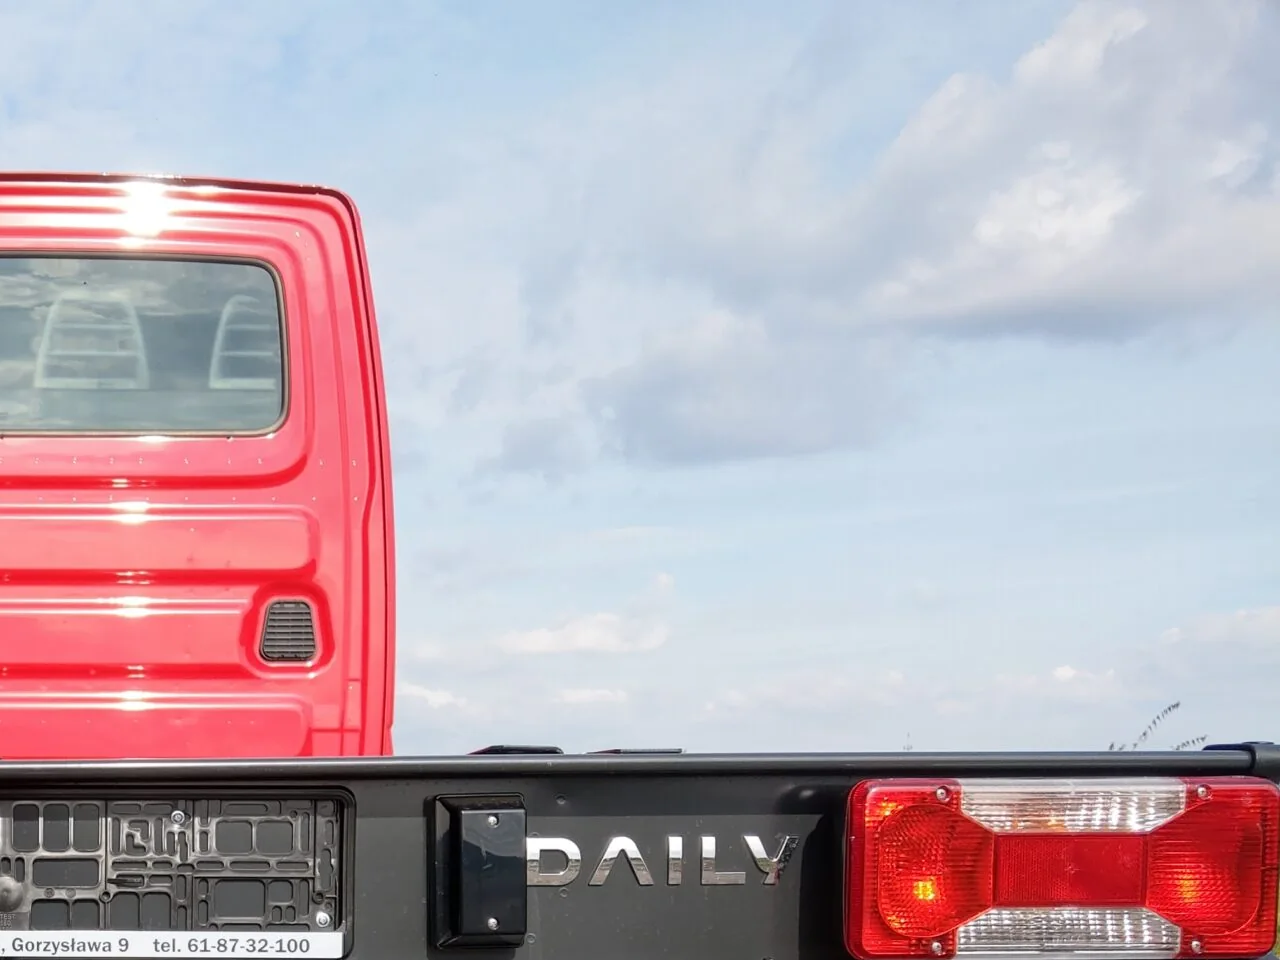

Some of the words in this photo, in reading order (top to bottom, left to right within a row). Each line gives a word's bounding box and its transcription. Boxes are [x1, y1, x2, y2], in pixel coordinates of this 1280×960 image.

[525, 834, 801, 886] DAILY
[11, 938, 112, 956] Gorzysława
[118, 938, 129, 953] 9
[153, 938, 182, 953] tel.
[187, 938, 311, 953] 61-87-32-100
